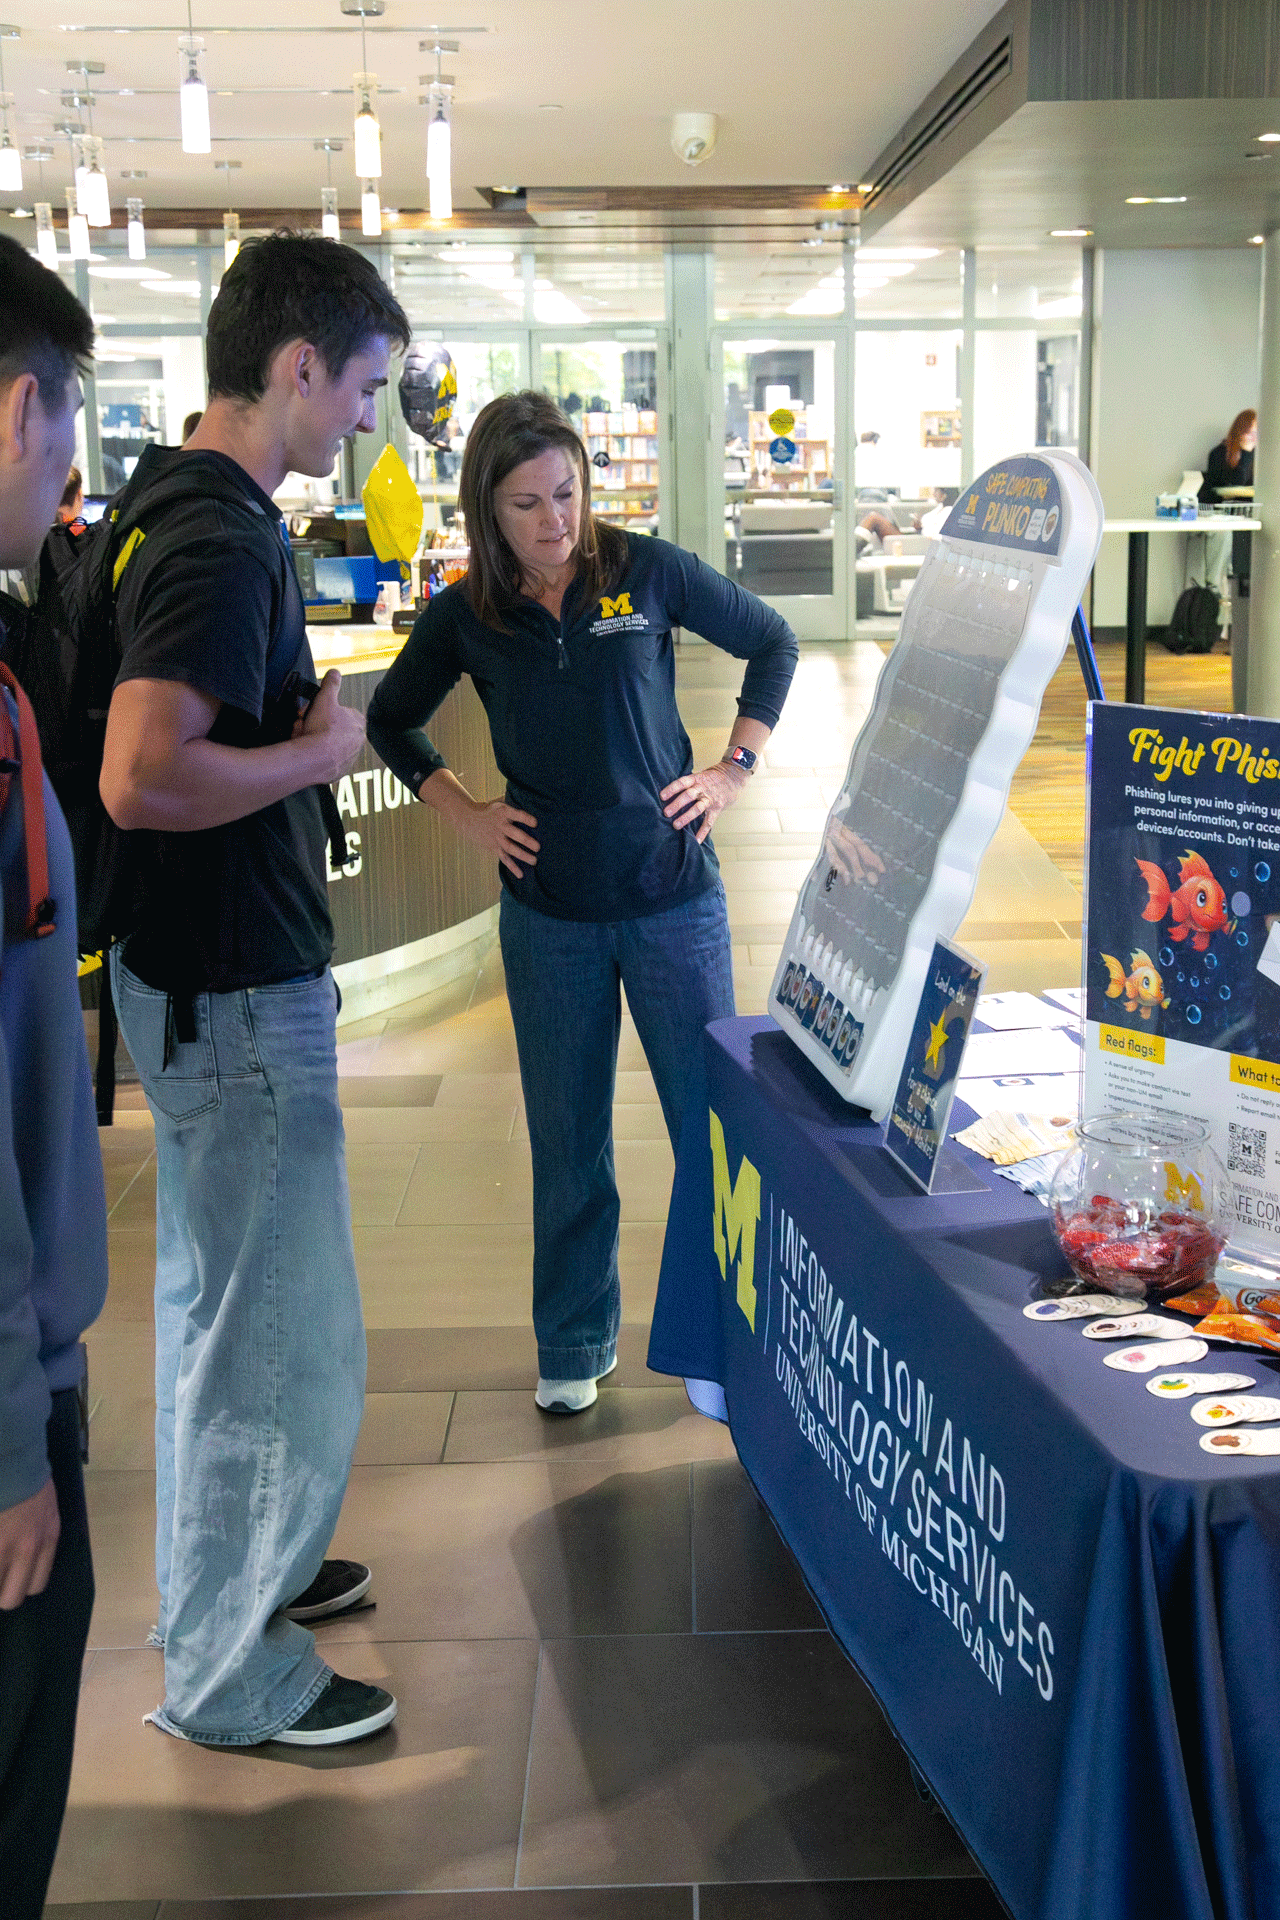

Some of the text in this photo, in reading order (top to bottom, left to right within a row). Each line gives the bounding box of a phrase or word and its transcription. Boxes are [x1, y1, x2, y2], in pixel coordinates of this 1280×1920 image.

[981, 502, 1030, 537] PLINKO
[599, 592, 634, 619] M
[589, 619, 650, 634] TECHNOLOGY SERVICES
[593, 613, 644, 627] INFORMATION AND
[1128, 727, 1280, 784] Fight Phis
[1125, 784, 1166, 804] Phishing
[1168, 790, 1192, 805] lures
[1194, 797, 1212, 809] you
[1214, 796, 1234, 811] into
[1236, 800, 1268, 818] giving
[1134, 805, 1177, 819] personal
[1178, 808, 1240, 830] information,
[1242, 821, 1255, 830] or
[1136, 819, 1280, 852] devices/accounts. Don't take
[1106, 1034, 1156, 1058] Red flags:
[1108, 1072, 1120, 1080] Asks
[1151, 1084, 1171, 1093] contact
[1113, 1062, 1127, 1070] sense
[1134, 1068, 1155, 1078] urgency
[1237, 1064, 1268, 1083] What
[1148, 1092, 1163, 1101] email
[1240, 1092, 1249, 1101] Do
[1250, 1095, 1259, 1103] not
[1260, 1098, 1275, 1108] reply
[1240, 1104, 1260, 1114] Report
[1260, 1111, 1276, 1120] email
[1163, 1161, 1205, 1212] M
[709, 1105, 761, 1336] M
[779, 1207, 1006, 1542] INFORMATION AND
[779, 1274, 1054, 1702] TECHNOLOGY SERVICES
[775, 1341, 1005, 1696] UNIVERSITY OF MICHIGAN
